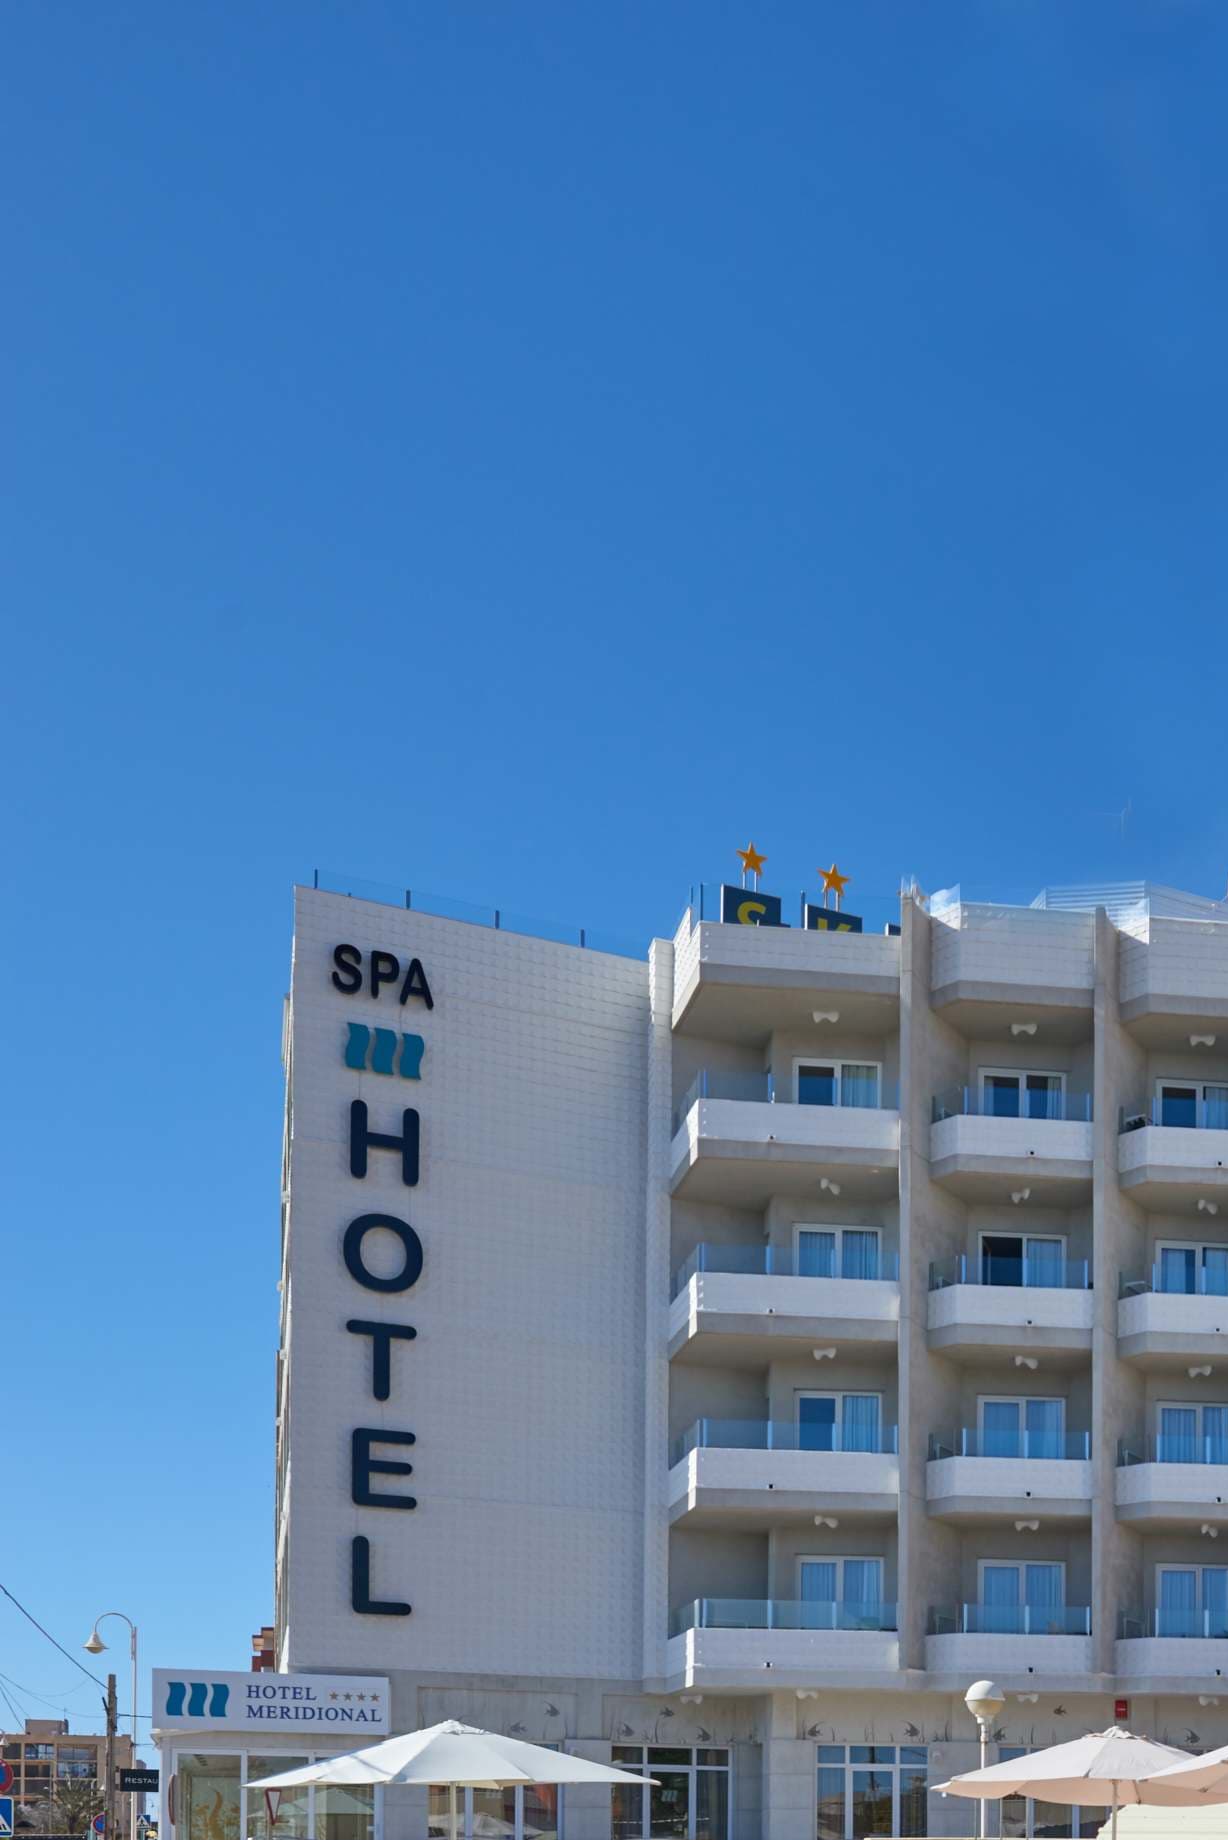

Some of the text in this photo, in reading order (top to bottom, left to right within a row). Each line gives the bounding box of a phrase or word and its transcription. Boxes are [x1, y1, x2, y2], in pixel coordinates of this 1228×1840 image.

[332, 943, 434, 1010] SPA
[343, 1099, 424, 1616] HOTEL
[246, 1684, 318, 1701] HOTEL
[246, 1704, 382, 1722] MERIDIONAL
